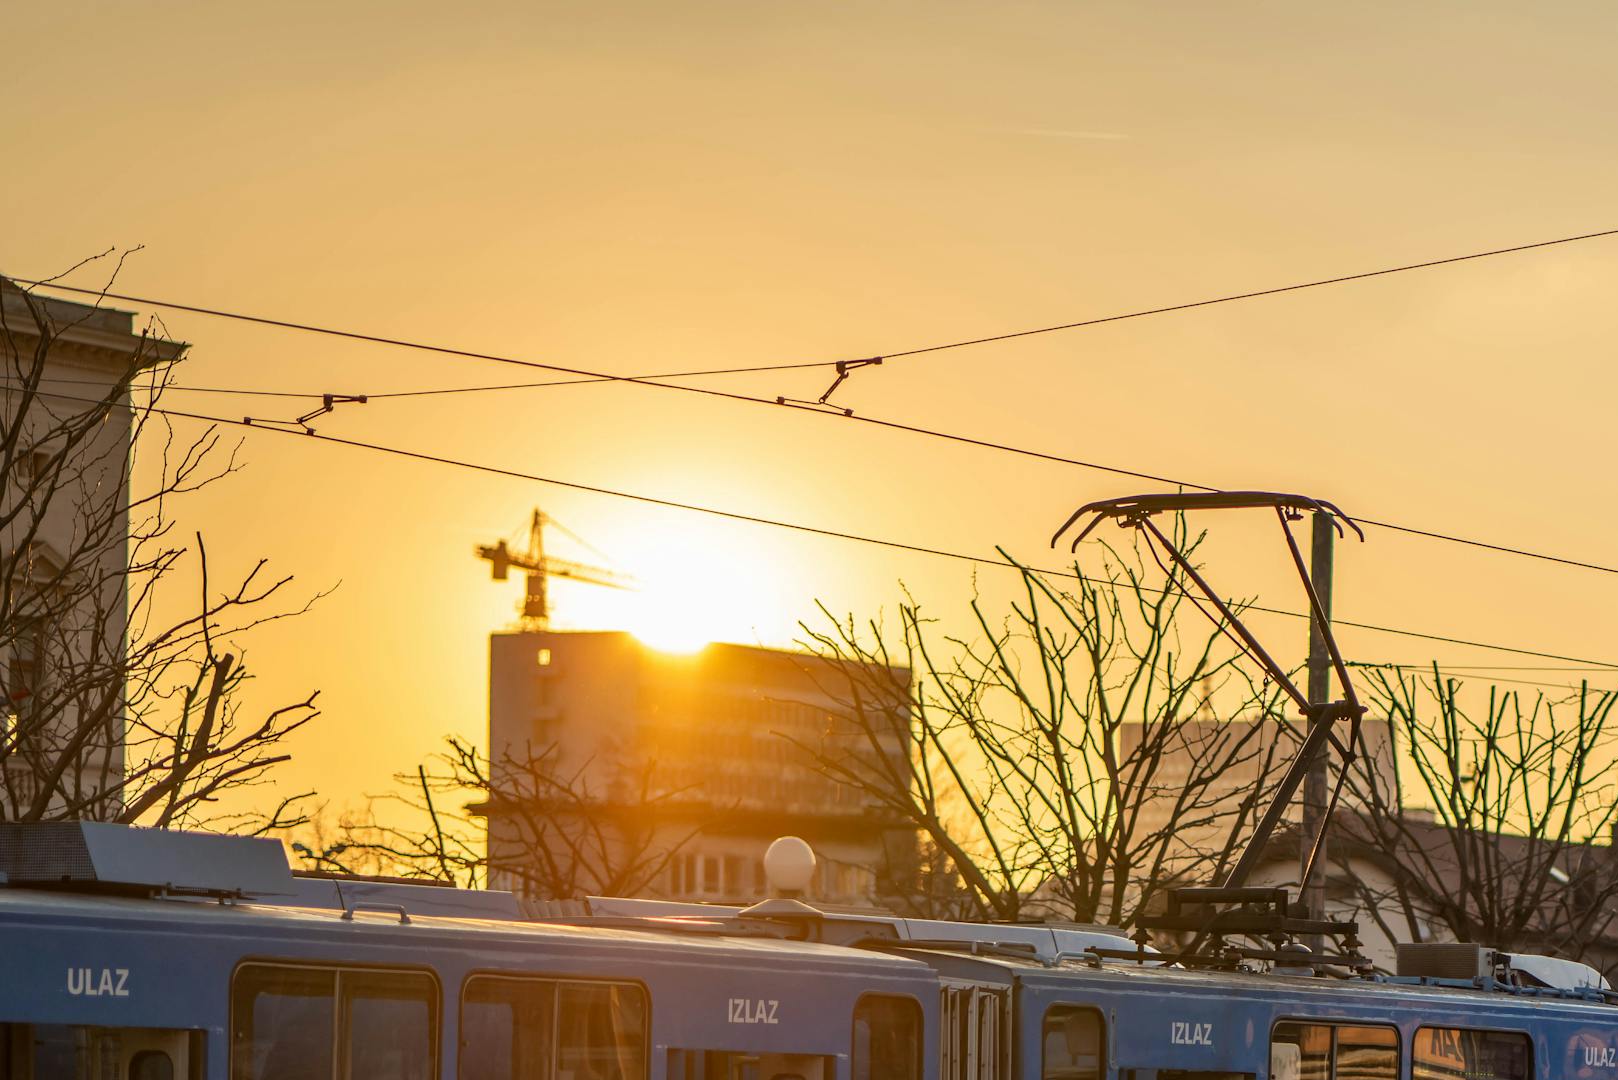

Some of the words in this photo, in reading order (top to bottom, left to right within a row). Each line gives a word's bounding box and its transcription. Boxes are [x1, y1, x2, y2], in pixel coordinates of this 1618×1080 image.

[67, 967, 130, 997] ULAZ
[728, 998, 779, 1024] IZLAZ
[1171, 1021, 1213, 1045] IZLAZ
[1585, 1046, 1616, 1067] ULAZ
